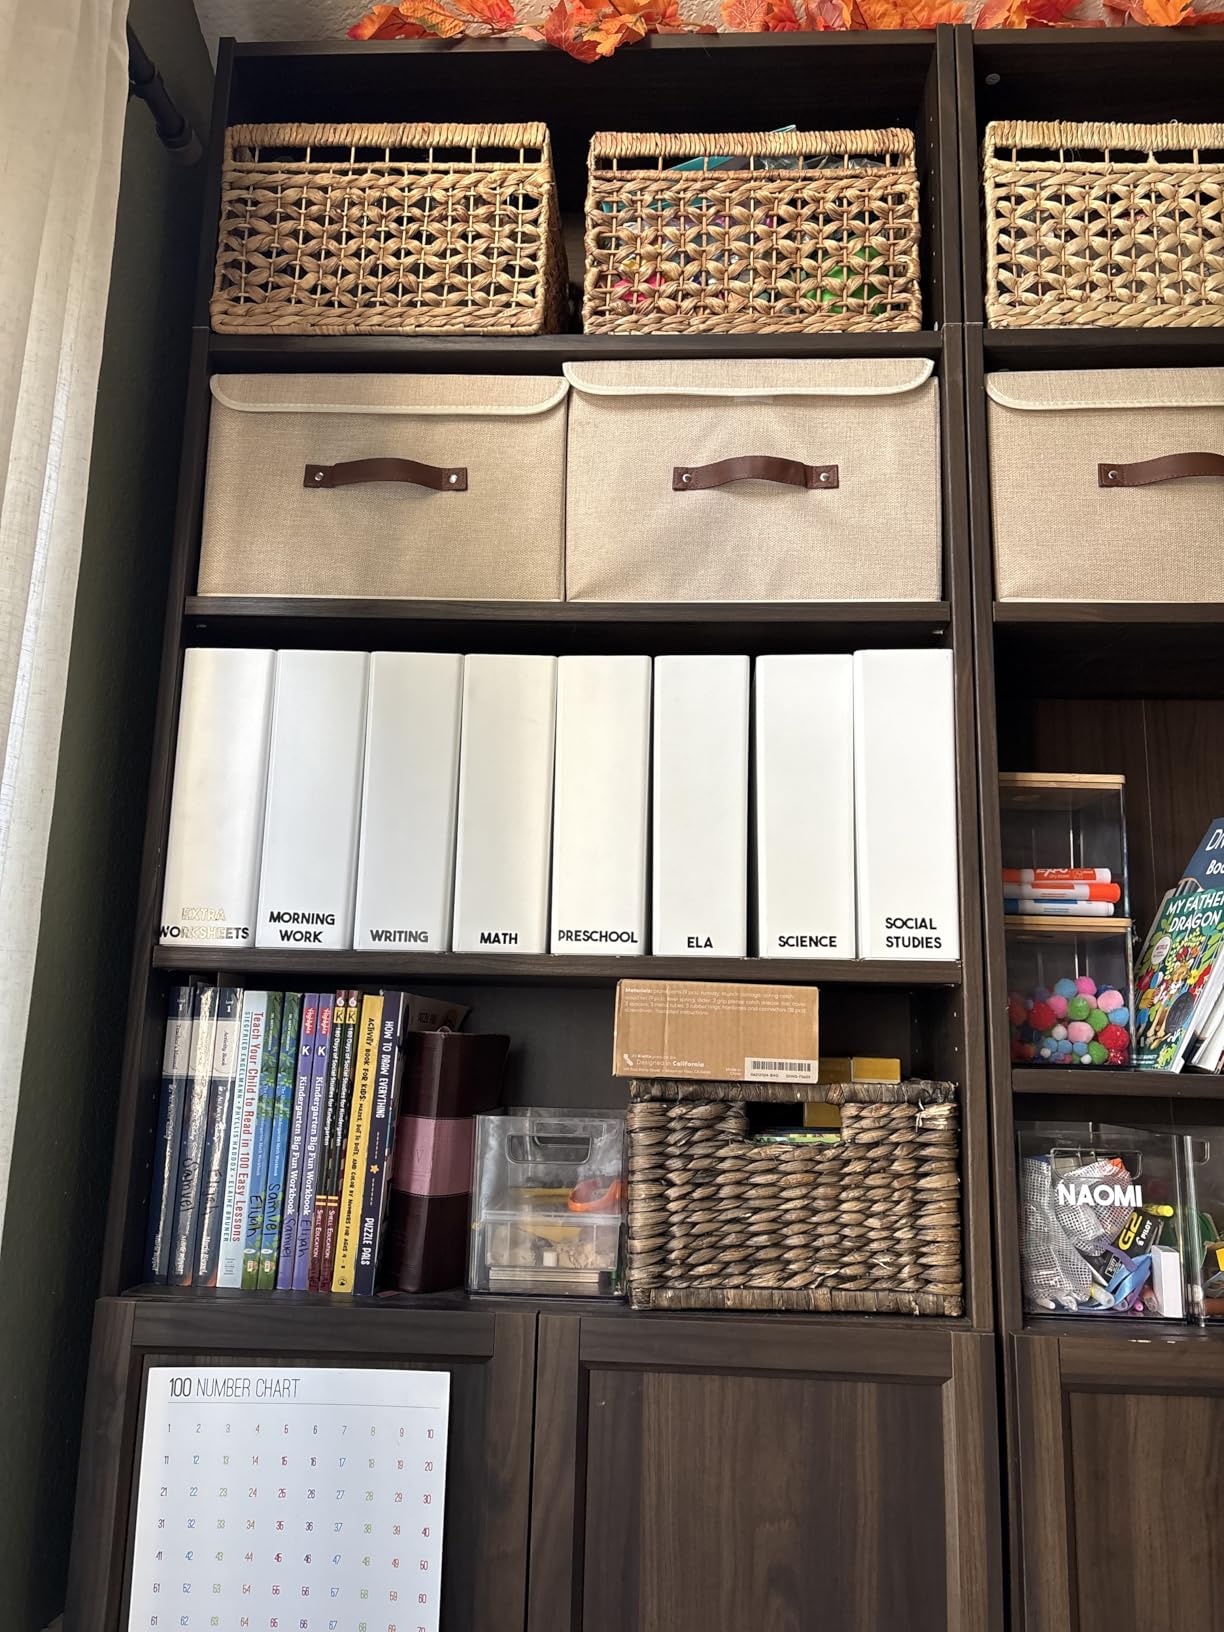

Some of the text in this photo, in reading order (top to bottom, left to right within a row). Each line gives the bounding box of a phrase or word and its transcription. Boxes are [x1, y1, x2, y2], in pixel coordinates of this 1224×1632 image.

[181, 908, 225, 921] EXTRA
[1166, 899, 1185, 915] MY
[268, 911, 336, 926] MORNING
[885, 917, 937, 930] SOCIAL
[1169, 910, 1222, 932] DRAGON
[160, 926, 249, 939] WORKSHEETS
[279, 930, 322, 943] WORK
[369, 929, 429, 943] WRITING
[479, 932, 518, 945] MATH
[558, 929, 638, 944] PRESCHOOL
[778, 935, 837, 948] SCIENCE
[687, 937, 713, 949] ELA
[885, 936, 942, 949] STUDIES
[334, 1009, 343, 1021] K
[346, 1009, 356, 1022] K
[241, 1012, 250, 1050] SIEGFRIED
[366, 1018, 374, 1046] ACTIVITY
[302, 1046, 310, 1055] K
[318, 1046, 326, 1056] K
[345, 1039, 353, 1052] Days
[237, 1054, 246, 1099] ENGELMANN
[341, 1078, 349, 1098] Studies
[233, 1106, 241, 1138] PHYLLIS
[233, 1012, 264, 1242] Teach Your Child to Read in 100 Easy Lessons
[324, 1108, 333, 1145] Kindergarten
[336, 1109, 345, 1146] Kindergarten
[287, 1076, 307, 1215] Kindergarten Big Fun Workbook
[303, 1077, 323, 1215] Kindergarten Big Fun Workbook
[361, 1021, 394, 1265] HOW TO DRAW EVERYTHING PUZZLE PALS
[180, 1158, 198, 1212] Samuel
[1058, 1184, 1142, 1207] NAOMI
[247, 1196, 262, 1237] Elijah
[264, 1184, 280, 1236] Samuel
[223, 1211, 231, 1242] BRUNER
[1118, 1211, 1143, 1250] G2
[1141, 1220, 1152, 1239] PILOT
[282, 1219, 295, 1257] Samuel
[298, 1220, 310, 1257] Elijah
[169, 1377, 301, 1399] 100 NUMBER CHART
[167, 1424, 172, 1432] 1
[195, 1424, 202, 1433] 2
[225, 1424, 231, 1433] 3
[255, 1424, 261, 1432] 4
[312, 1425, 318, 1434] 6
[341, 1426, 348, 1435] 7
[370, 1426, 376, 1436] 8
[399, 1428, 405, 1437] 9
[427, 1428, 434, 1440] 10
[164, 1455, 170, 1465] 11
[192, 1454, 200, 1465] 12
[222, 1455, 230, 1465] 13
[251, 1455, 259, 1465] 14
[310, 1456, 317, 1467] 16
[338, 1457, 347, 1468] 17
[368, 1457, 376, 1470] 18
[397, 1459, 404, 1470] 19
[424, 1460, 434, 1472] 20
[160, 1486, 168, 1497] 21
[189, 1486, 199, 1497] 22
[218, 1487, 228, 1498] 23
[248, 1487, 258, 1498] 24
[306, 1488, 316, 1500] 26
[335, 1489, 346, 1500] 27
[364, 1490, 375, 1502] 28
[394, 1491, 403, 1503] 29
[423, 1493, 432, 1505] 30
[157, 1518, 166, 1529] 31
[187, 1518, 196, 1529] 32
[216, 1519, 226, 1530] 33
[246, 1519, 256, 1530] 34
[305, 1521, 314, 1532] 36
[333, 1522, 344, 1533] 37
[363, 1523, 373, 1535] 38
[392, 1524, 401, 1536] 39
[421, 1527, 430, 1538] 40
[155, 1550, 163, 1561] 41
[184, 1550, 194, 1561] 42
[214, 1551, 224, 1562] 43
[244, 1551, 254, 1562] 44
[303, 1553, 312, 1564] 46
[332, 1554, 342, 1565] 47
[361, 1556, 371, 1567] 48
[391, 1558, 400, 1569] 49
